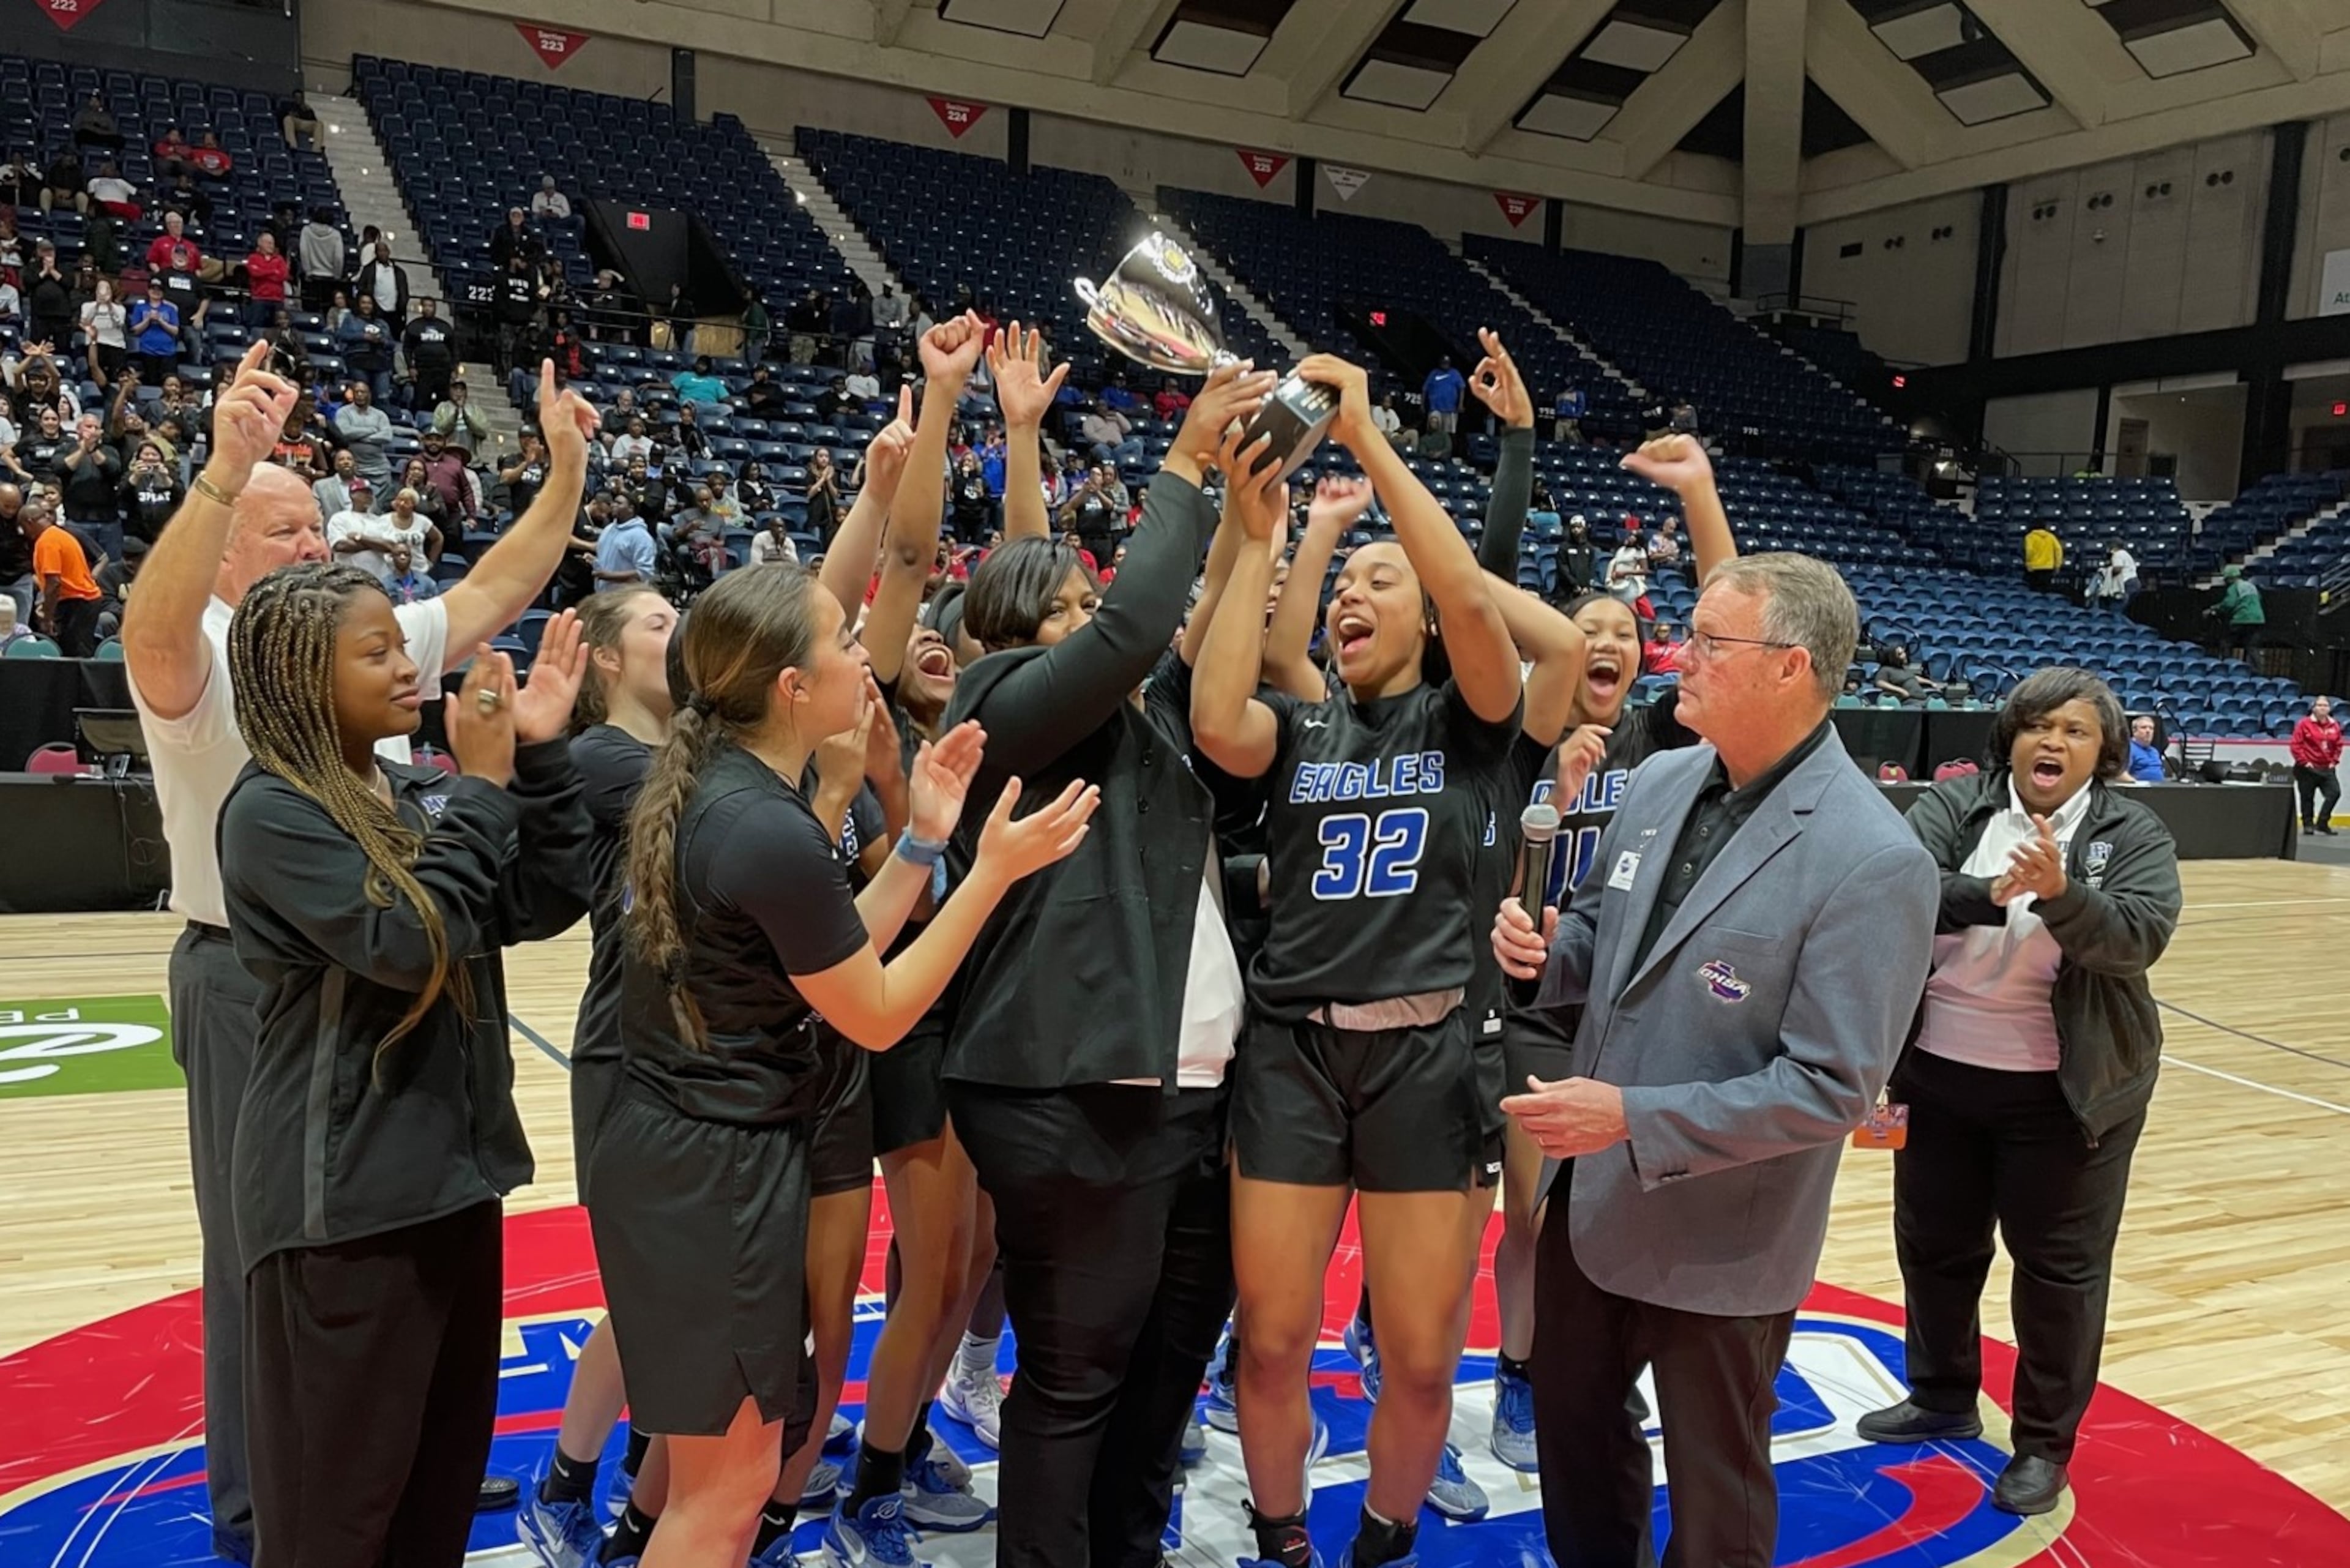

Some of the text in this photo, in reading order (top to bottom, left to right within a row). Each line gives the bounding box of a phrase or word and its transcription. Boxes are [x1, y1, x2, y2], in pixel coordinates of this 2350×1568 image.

[50, 0, 78, 12] 222
[540, 39, 565, 52] 223
[947, 110, 968, 123] 224
[1289, 750, 1444, 804] EAGLES
[1311, 807, 1430, 901] 32
